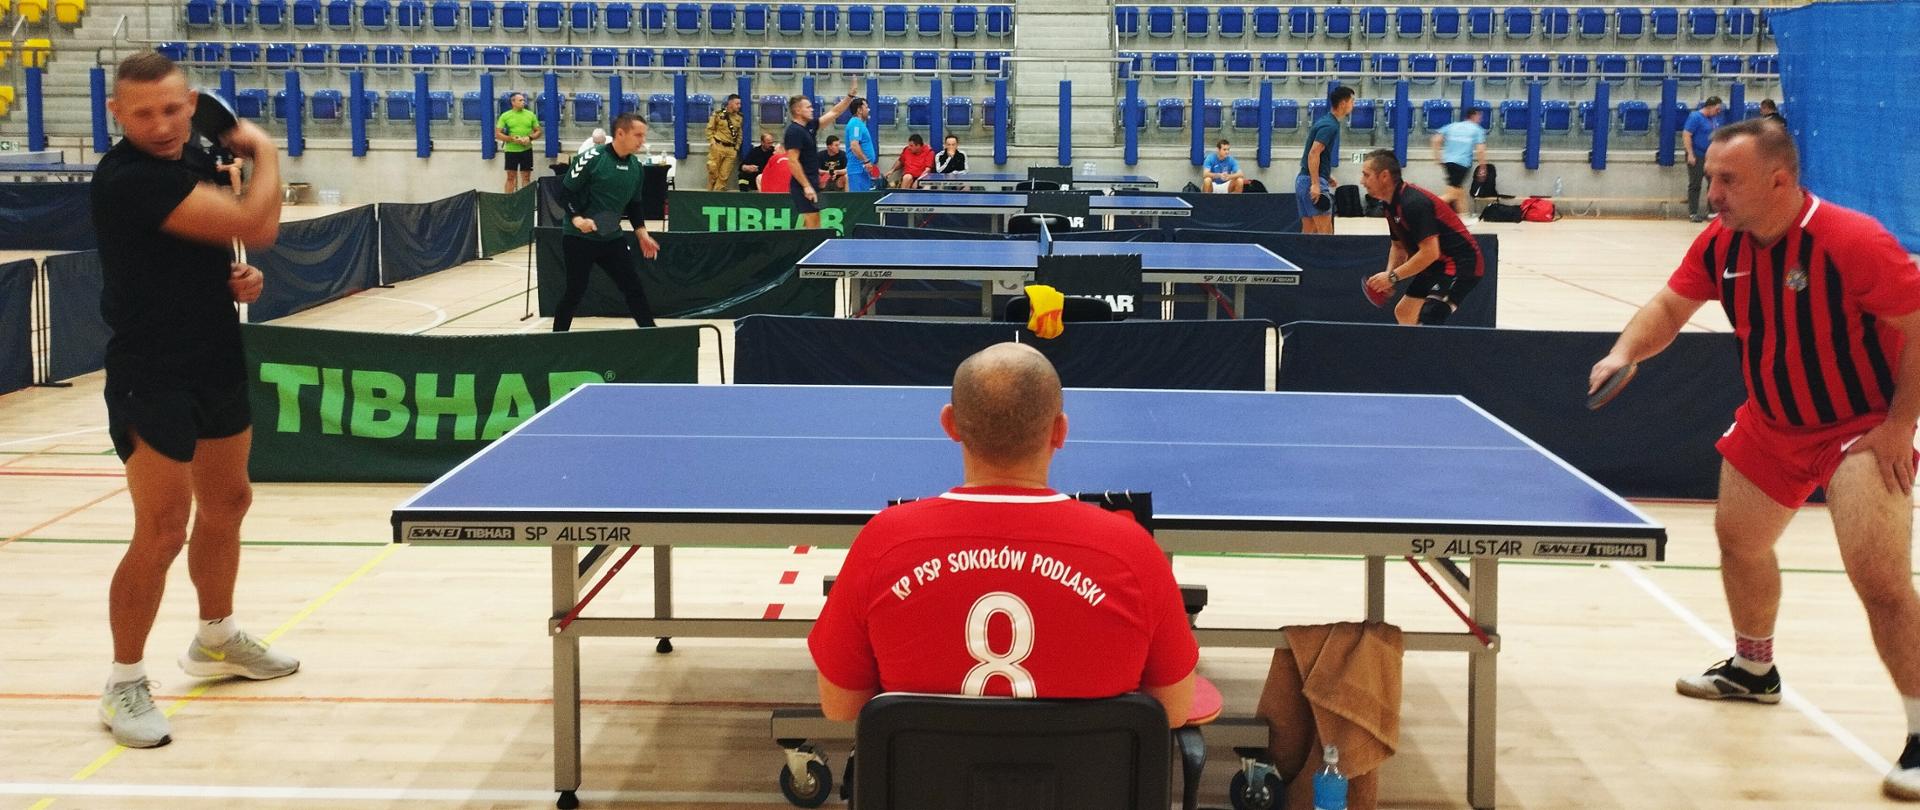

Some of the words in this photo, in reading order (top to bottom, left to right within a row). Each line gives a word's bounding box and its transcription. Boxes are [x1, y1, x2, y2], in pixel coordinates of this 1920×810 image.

[465, 528, 512, 539] TIBHAR
[525, 527, 548, 540] SP
[556, 527, 631, 541] ALLSTAR
[1411, 539, 1435, 553] SP
[1444, 540, 1522, 555] ALLSTAR
[1595, 545, 1646, 556] TIBHAR
[891, 576, 912, 600] KP
[913, 558, 942, 586] PSP
[947, 545, 1027, 573] SOKOŁÓW
[1030, 553, 1106, 607] PODLASKI
[960, 591, 1037, 699] 8
